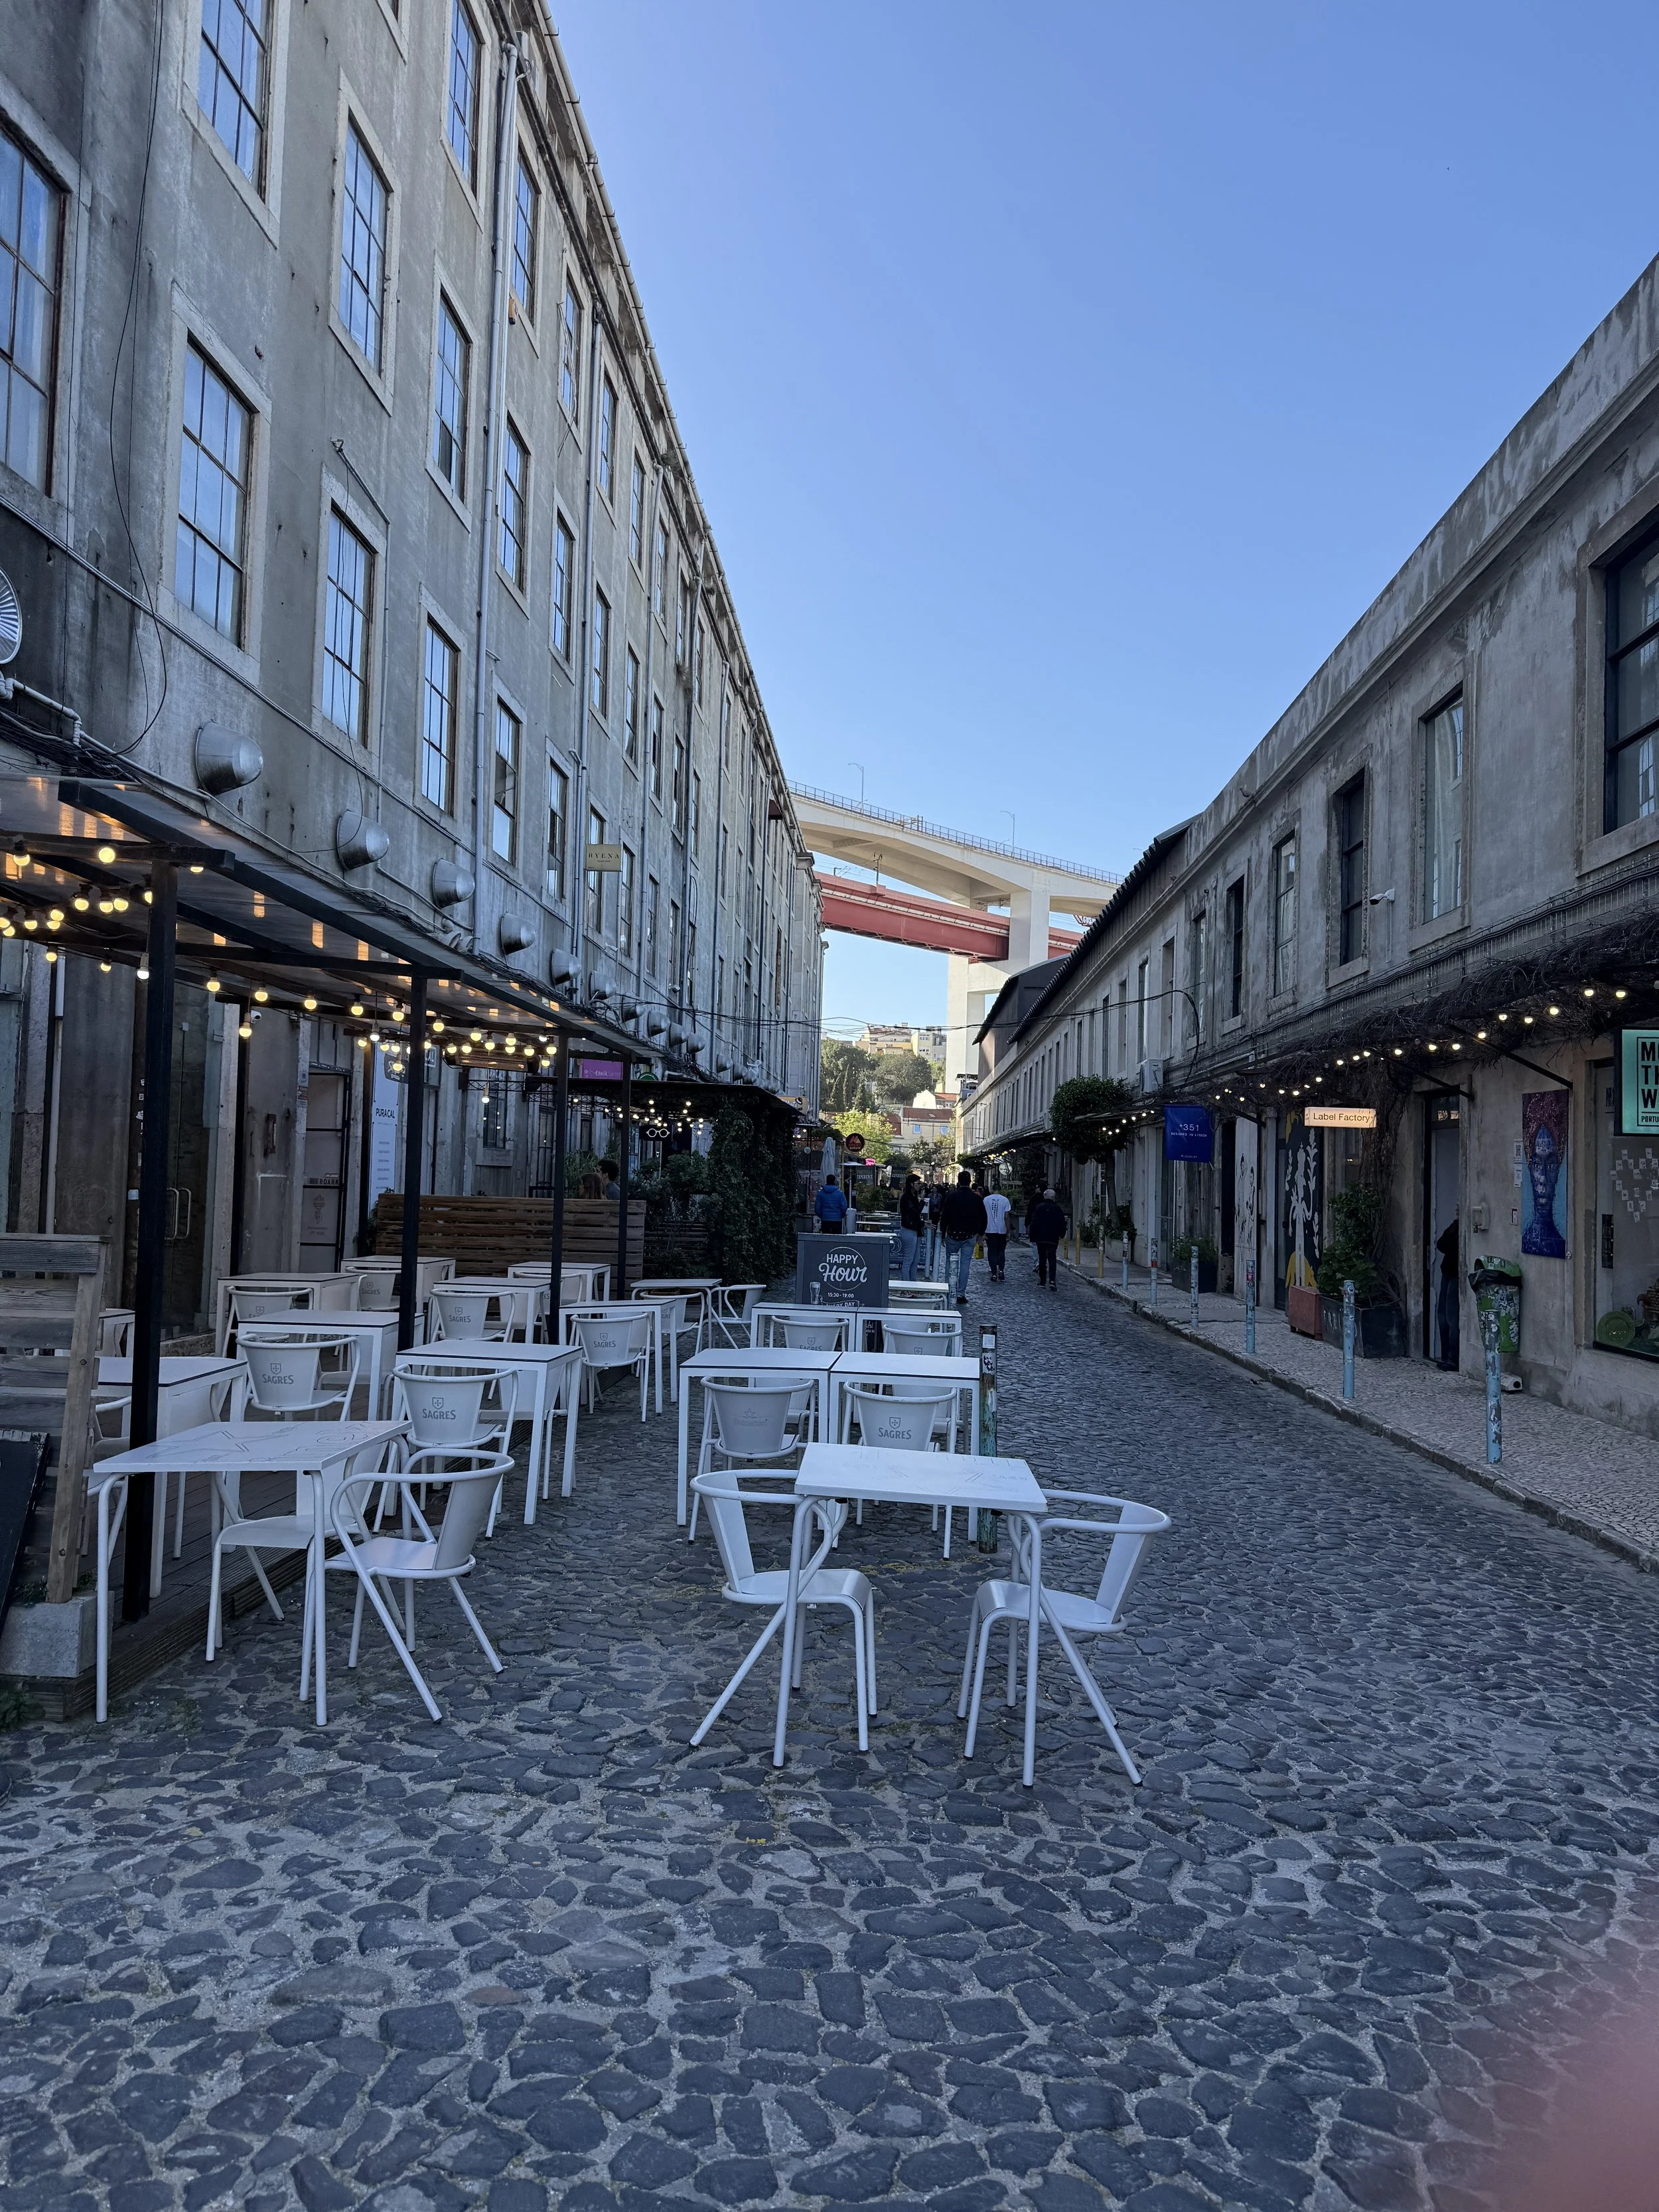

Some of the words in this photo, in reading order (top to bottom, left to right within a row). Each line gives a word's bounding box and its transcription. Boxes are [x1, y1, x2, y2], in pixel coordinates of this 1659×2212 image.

[1641, 1041, 1659, 1061] M
[1313, 1112, 1336, 1121] Label
[1338, 1113, 1370, 1123] Factory
[826, 1253, 858, 1264] HAPPY
[818, 1262, 867, 1283] Hour
[261, 1374, 294, 1384] SAGRES
[422, 1408, 457, 1420] SAGRES
[878, 1427, 912, 1440] SAGRES
